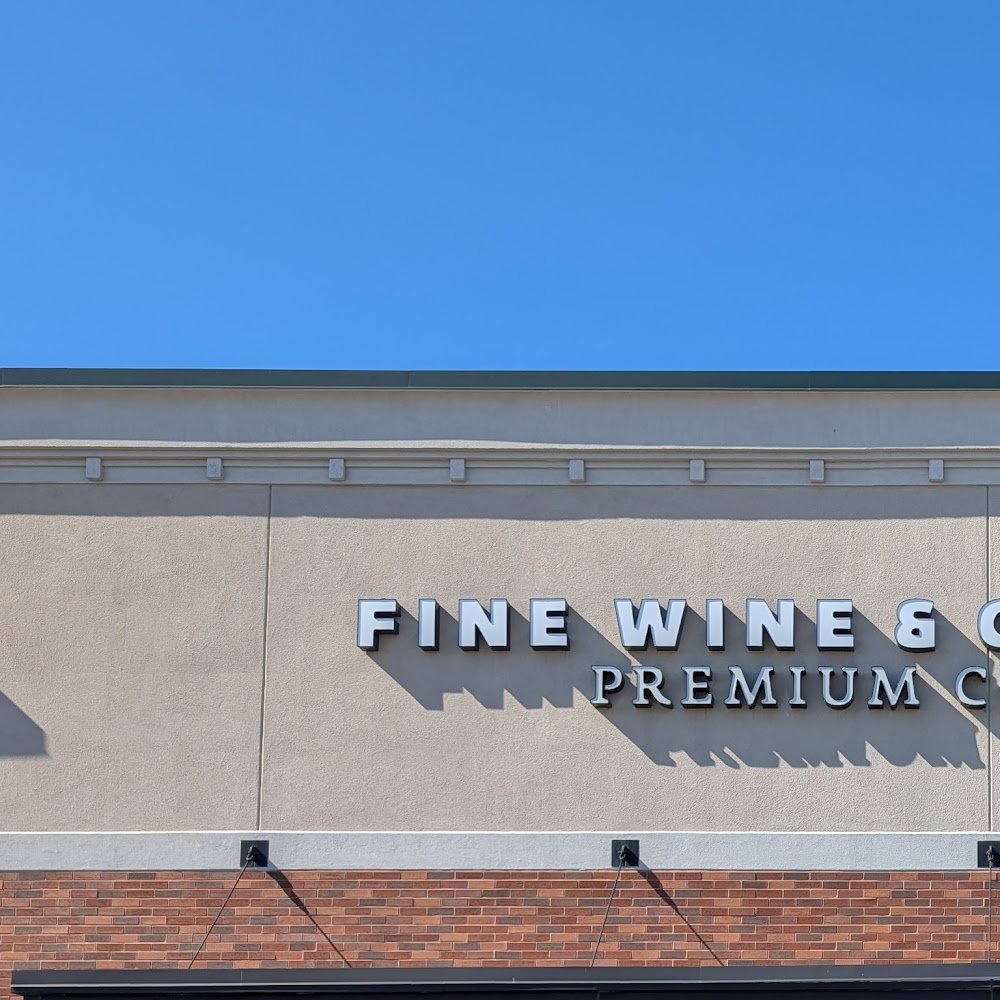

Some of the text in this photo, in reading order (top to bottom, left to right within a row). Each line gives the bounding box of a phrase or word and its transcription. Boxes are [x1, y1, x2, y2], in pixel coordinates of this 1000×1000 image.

[356, 598, 571, 652] FINE
[613, 598, 855, 652] WINE
[894, 597, 937, 653] &
[590, 664, 920, 710] PREMIUM
